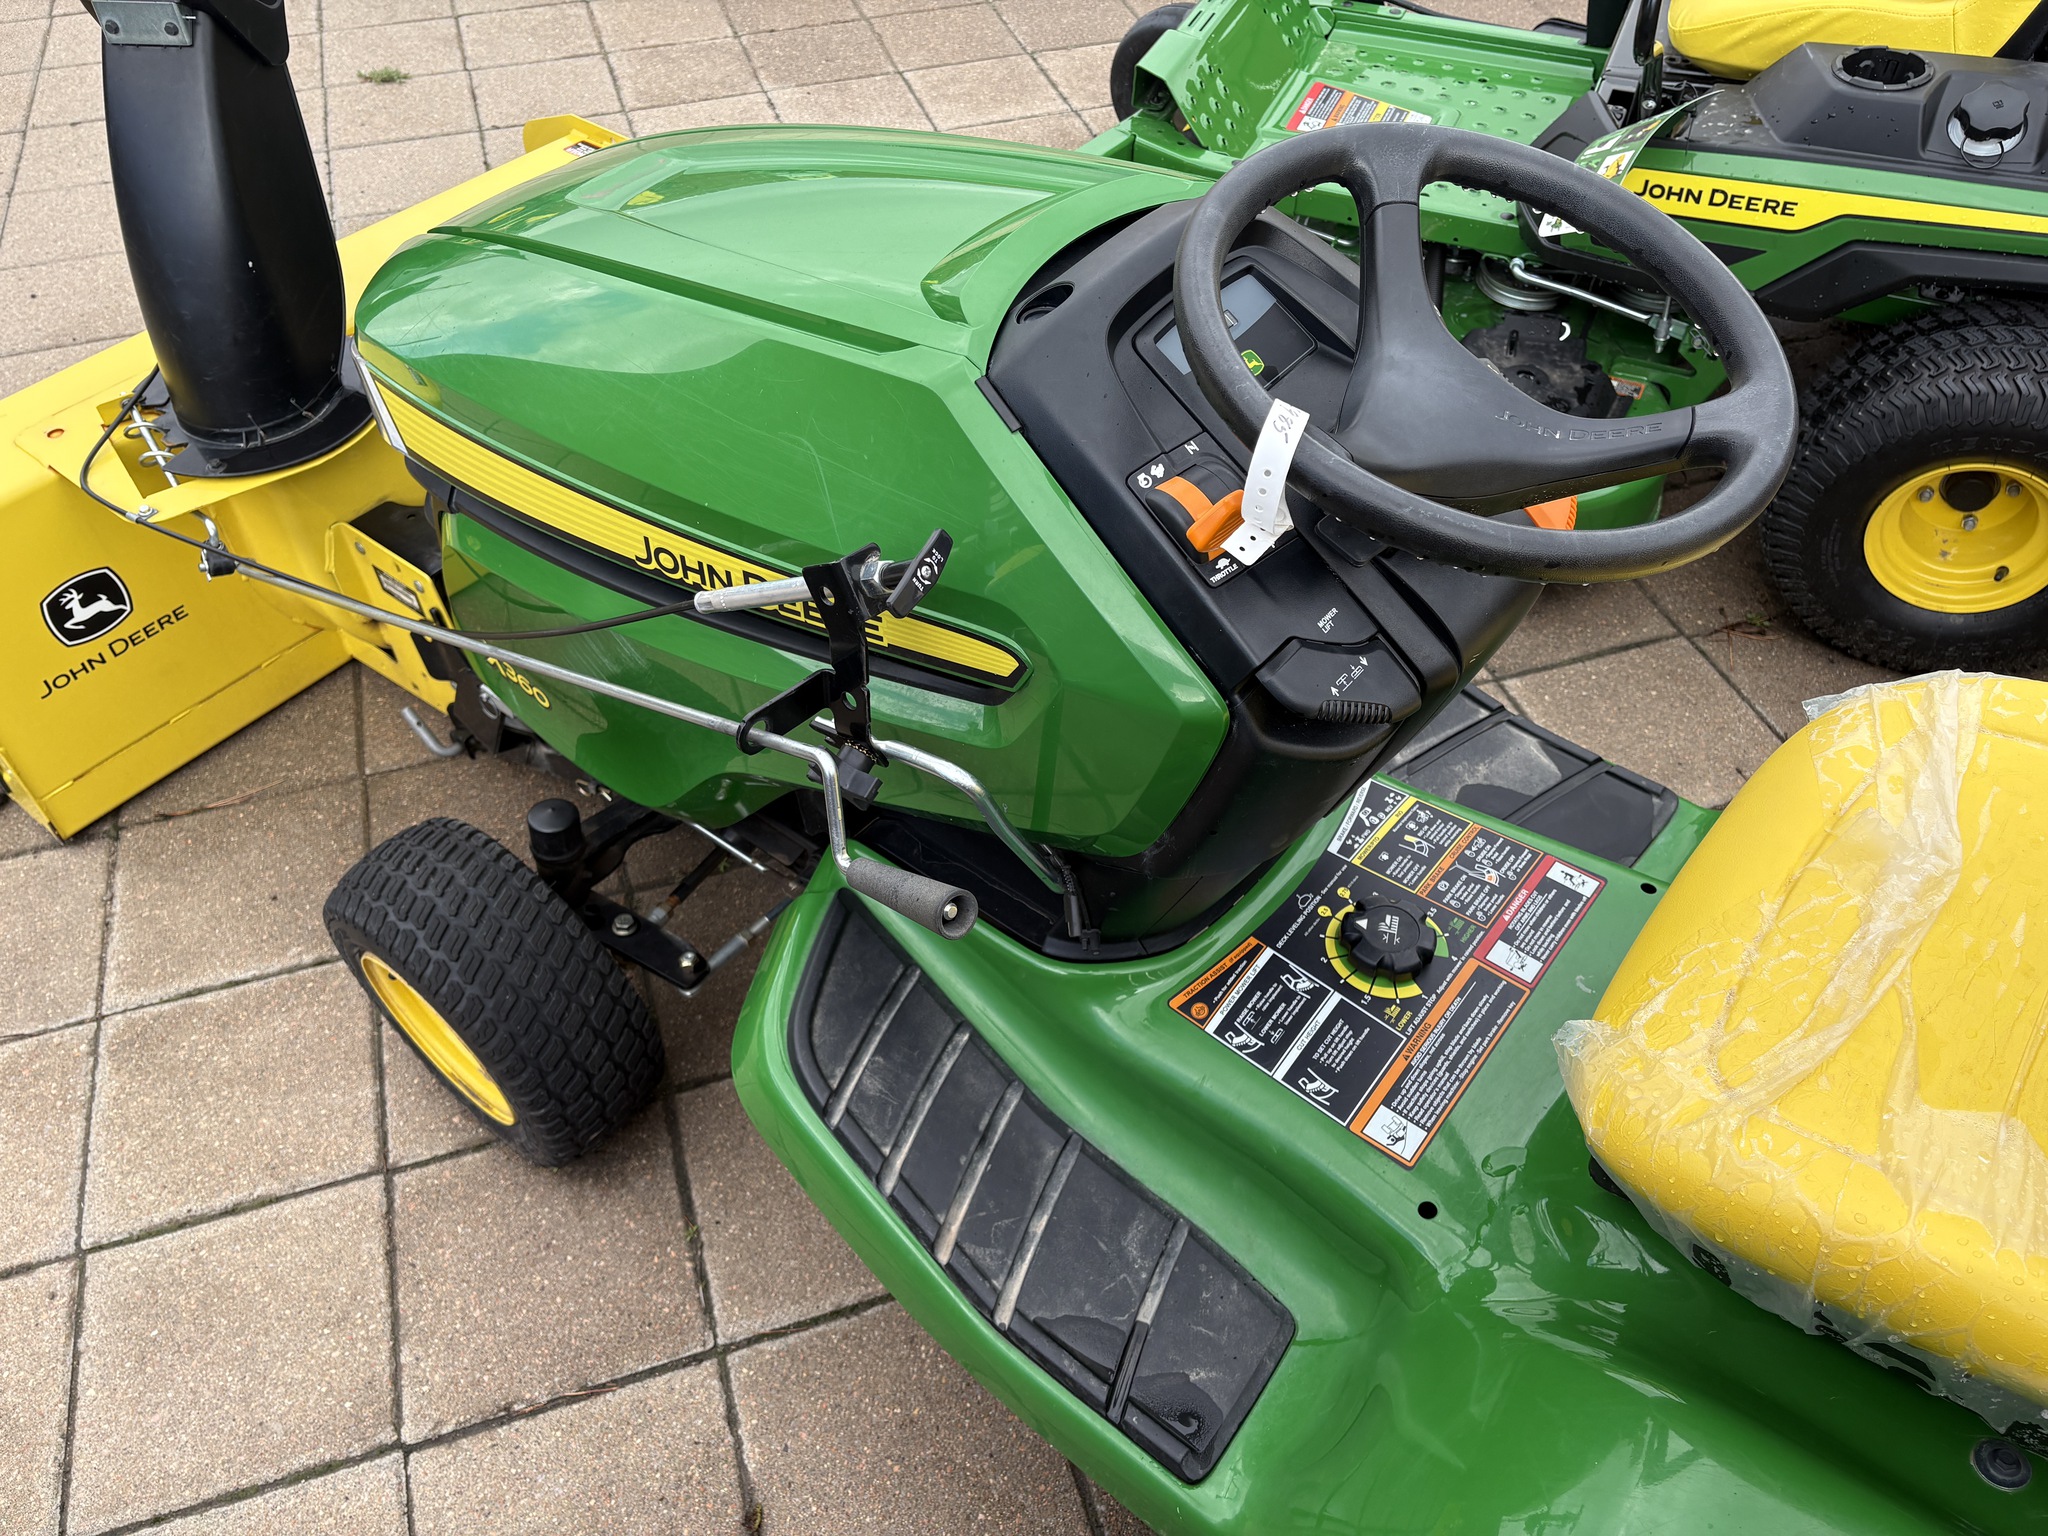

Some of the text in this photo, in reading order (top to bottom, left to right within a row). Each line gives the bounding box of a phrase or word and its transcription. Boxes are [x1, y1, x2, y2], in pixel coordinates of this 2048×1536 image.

[1634, 179, 1799, 217] JOHN DEERE
[1495, 410, 1663, 441] JOHN DEERE
[635, 536, 733, 590] JOHN
[1209, 563, 1239, 583] THROTTLE
[1317, 607, 1339, 629] MOWER
[1322, 620, 1335, 634] LIFT
[41, 604, 190, 700] JOHN DEERE
[1339, 887, 1349, 896] 2.75
[1418, 866, 1445, 895] PARK BRAKE
[1320, 907, 1328, 915] 2.5
[1426, 906, 1438, 917] 3.5
[1505, 888, 1529, 915] DANGER
[1275, 934, 1289, 948] DECK
[1286, 914, 1306, 936] LEVELING
[1302, 894, 1322, 915] POSITION
[1459, 924, 1477, 943] HIGHER
[1449, 954, 1459, 962] 4
[1182, 976, 1210, 997] TRACTION
[1207, 962, 1227, 977] ASSIST
[1219, 964, 1260, 1015] POWER MOWER LIFT
[1235, 990, 1262, 1022] RAISE MOWER
[1360, 994, 1371, 1005] 1.5
[1258, 1002, 1286, 1036] LOWER MOWER
[1395, 1010, 1413, 1031] LOWER
[1296, 1019, 1321, 1051] CUT HEIGHT
[1312, 1018, 1345, 1060] TO SET CUT HEIGHT
[1404, 1021, 1432, 1055] WARNING
